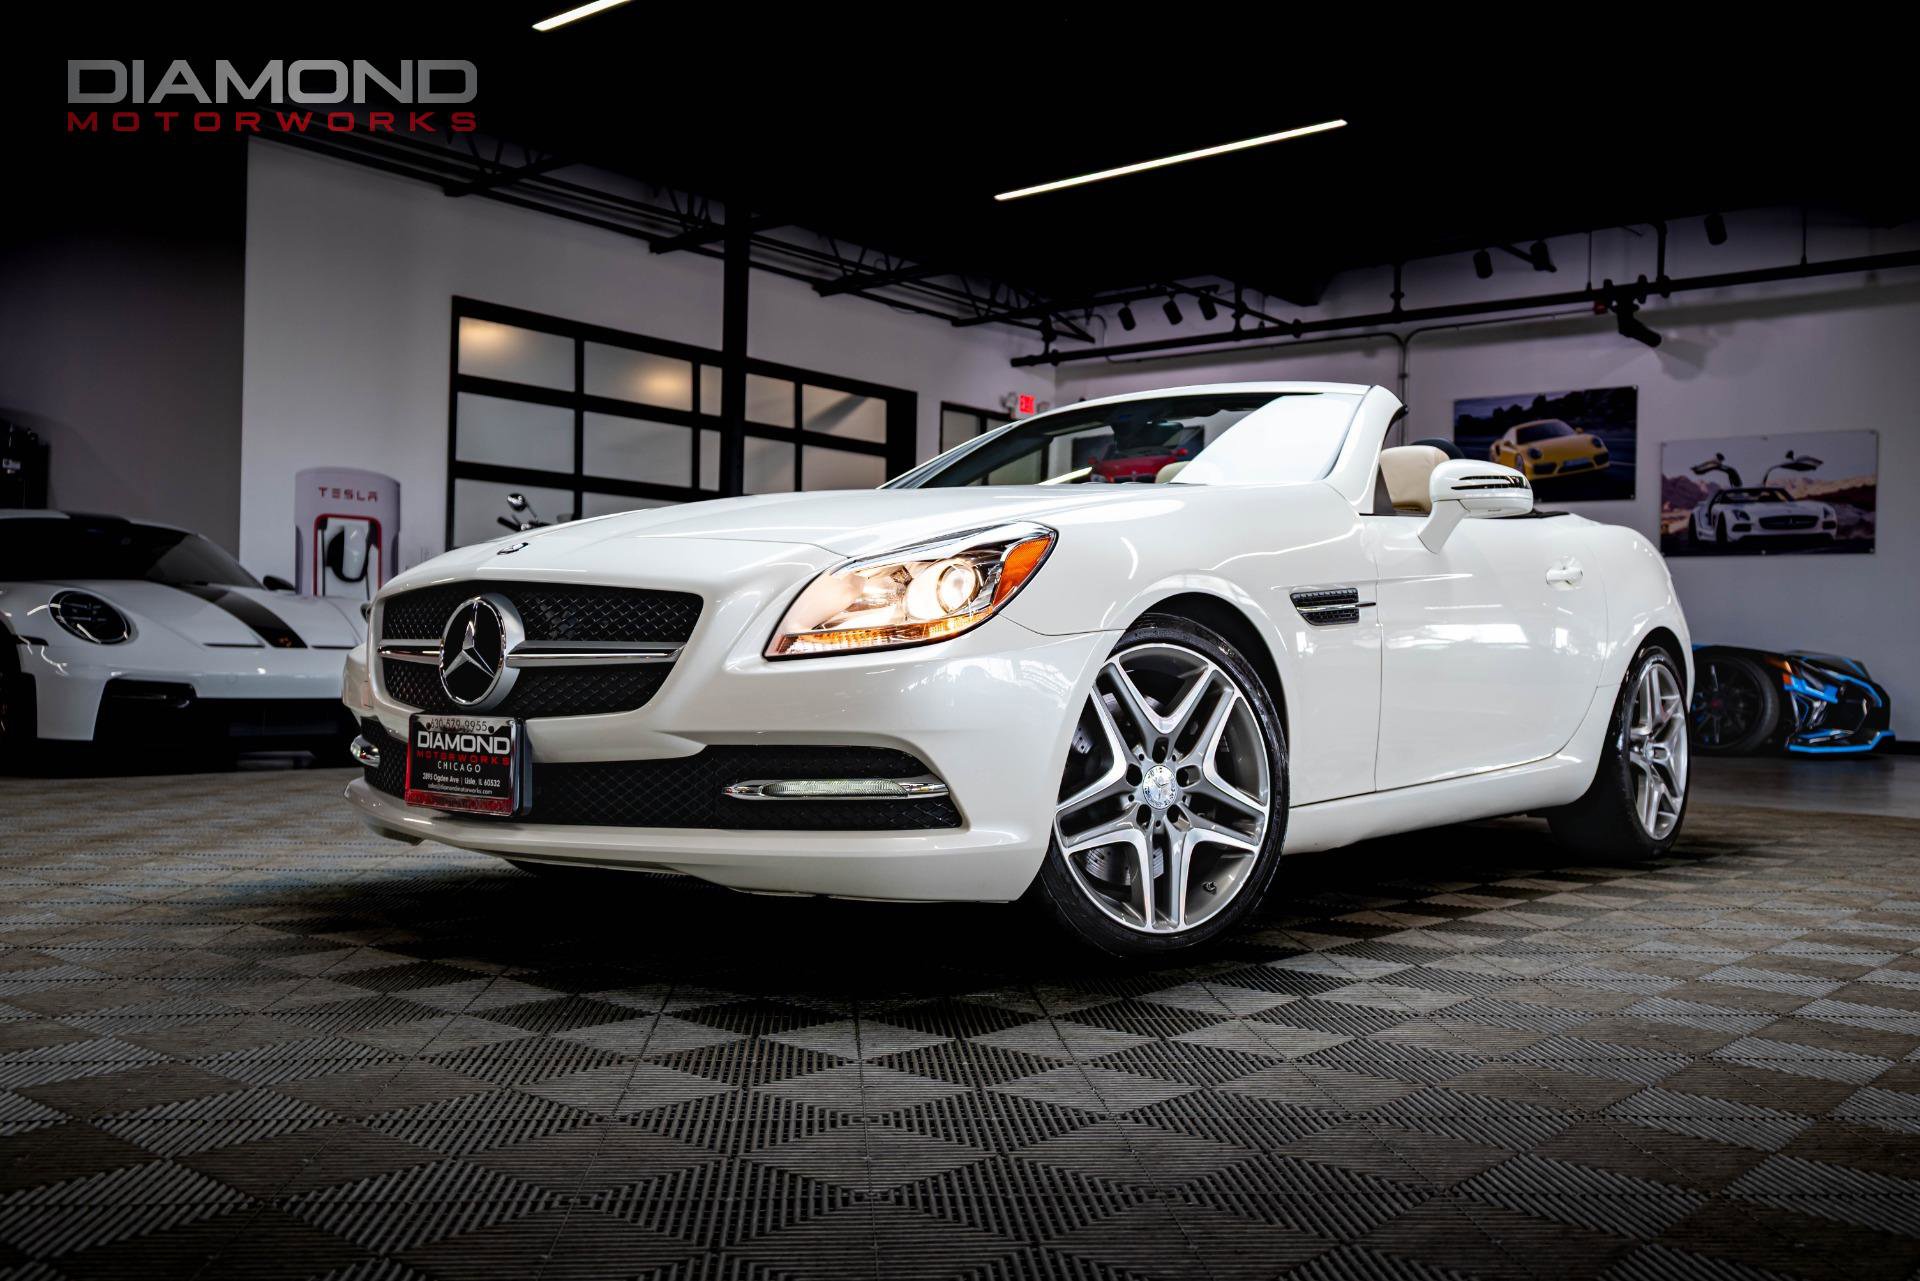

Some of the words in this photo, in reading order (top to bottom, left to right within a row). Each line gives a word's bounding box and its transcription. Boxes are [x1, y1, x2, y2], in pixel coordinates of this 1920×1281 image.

[318, 486, 378, 502] TESLA
[417, 730, 511, 755] DIAMOND
[416, 750, 511, 766] MOTORWORKS
[437, 760, 481, 773] CHICAGO
[433, 773, 450, 783] Ogden
[449, 775, 460, 783] Ave
[483, 779, 501, 787] 60532
